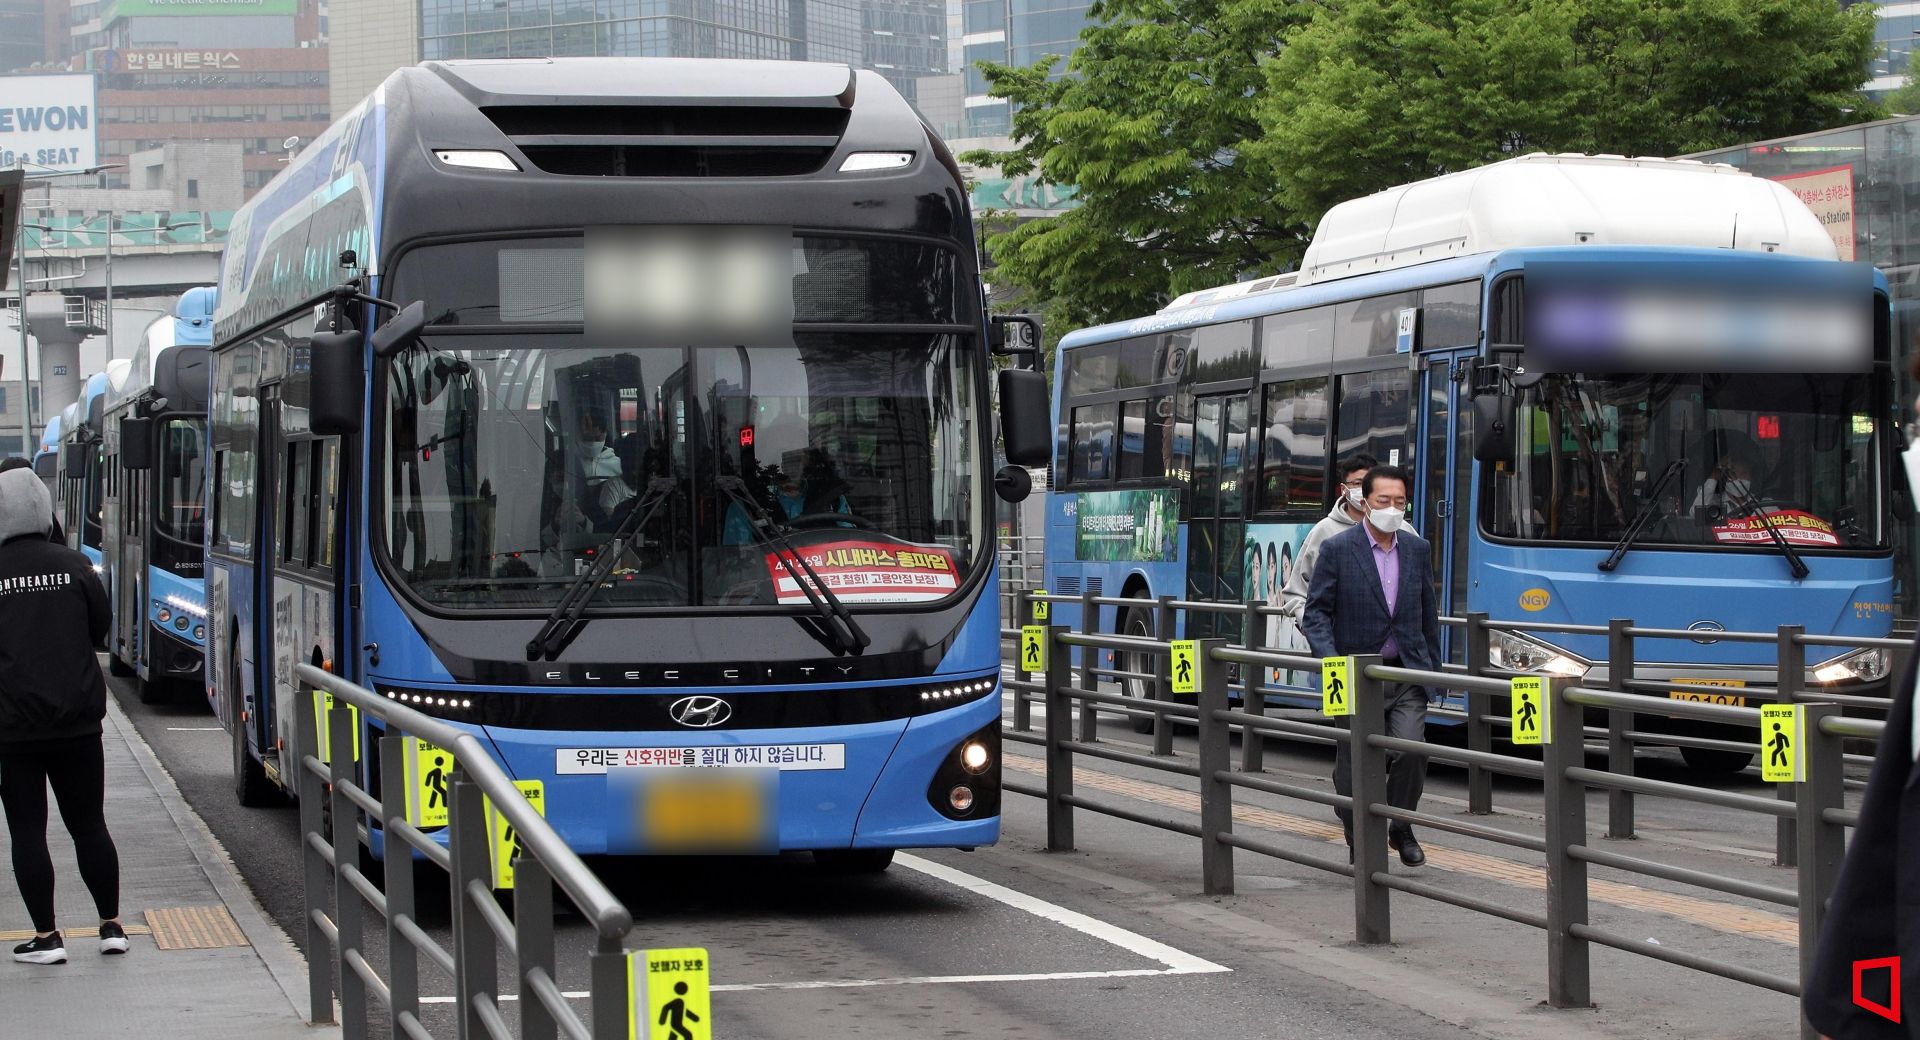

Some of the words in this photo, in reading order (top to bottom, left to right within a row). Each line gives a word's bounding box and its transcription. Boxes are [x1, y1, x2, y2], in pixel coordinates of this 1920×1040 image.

[127, 52, 241, 70] 한일네트웍스
[0, 105, 88, 132] EWON
[37, 147, 79, 165] SEAT
[1827, 210, 1850, 225] Station
[825, 548, 897, 567] 시내버스
[895, 551, 950, 571] 총파업
[804, 574, 842, 587] 금동결
[843, 573, 869, 586] 철회!
[871, 573, 913, 585] 고용안정
[914, 574, 940, 586] 보장!
[1521, 595, 1550, 606] NGV
[546, 670, 679, 680] ELEC
[723, 666, 853, 678] CITY
[1781, 710, 1793, 718] 보호
[576, 750, 619, 766] 우리는
[624, 748, 696, 766] 신호위반을
[701, 748, 729, 764] 절대
[734, 747, 762, 764] 하지
[767, 746, 826, 763] 않습니다.
[525, 789, 540, 799] 보호
[650, 960, 681, 973] 보행자
[683, 959, 704, 971] 보호
